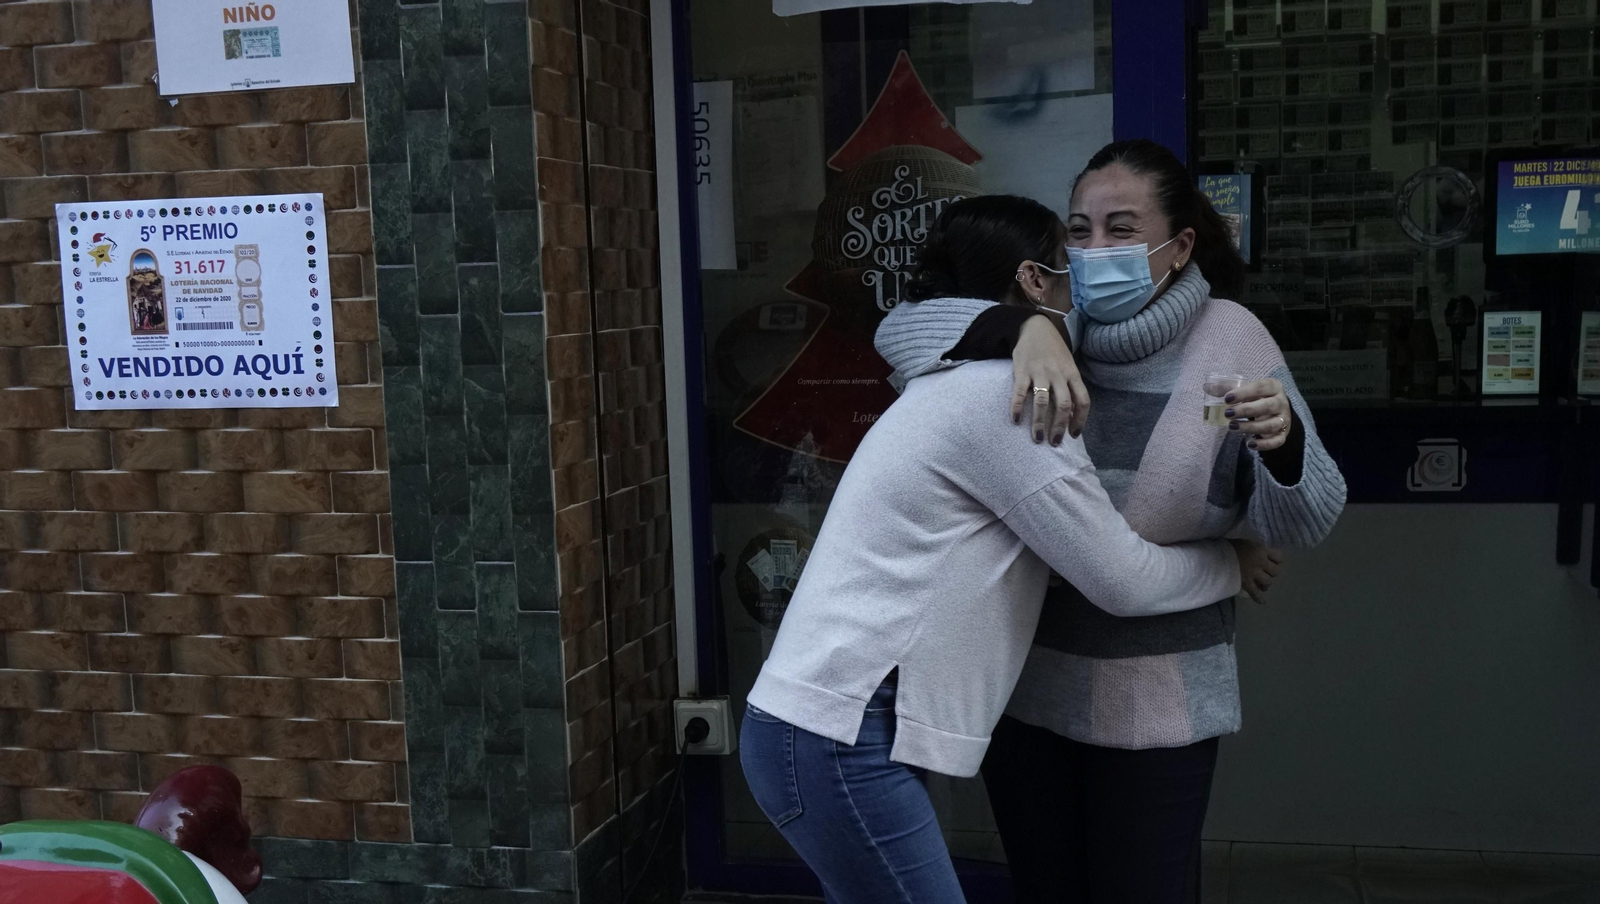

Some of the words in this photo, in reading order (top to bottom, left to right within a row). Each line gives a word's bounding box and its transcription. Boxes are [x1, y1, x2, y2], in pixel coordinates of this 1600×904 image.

[222, 2, 276, 24] NIÑO
[692, 101, 712, 187] 50635
[1514, 162, 1547, 173] MARTES
[1554, 161, 1564, 171] 22
[1218, 177, 1232, 188] que
[1513, 175, 1541, 187] JUEGA
[162, 222, 239, 241] PREMIO
[841, 194, 967, 260] SORT
[873, 245, 918, 272] QUE
[174, 259, 226, 275] 31.617
[1249, 283, 1300, 293] DEPORTIVAS
[1502, 316, 1522, 325] BOTES
[97, 354, 225, 379] VENDIDO
[232, 346, 305, 381] AQUÍ
[797, 377, 832, 387] Compartir
[832, 378, 851, 386] como
[851, 377, 881, 387] siempre.
[1335, 387, 1345, 395] EN
[1346, 387, 1354, 395] EL
[852, 411, 883, 425] Lote
